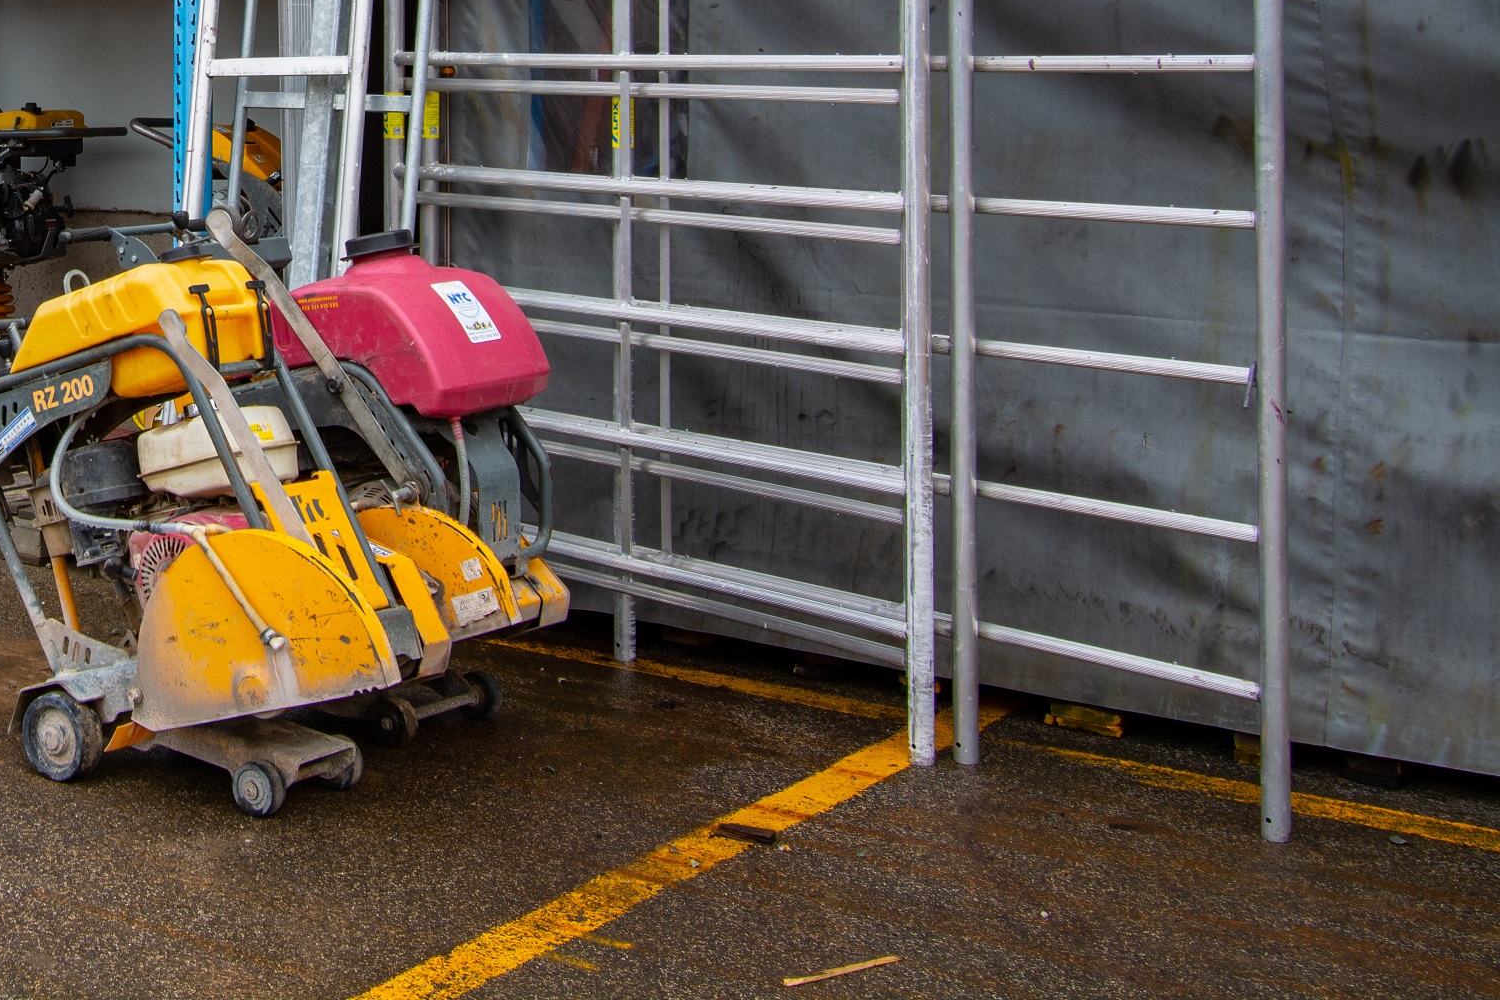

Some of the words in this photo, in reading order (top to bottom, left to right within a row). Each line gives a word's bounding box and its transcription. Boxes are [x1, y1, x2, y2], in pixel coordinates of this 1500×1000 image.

[447, 292, 472, 304] NTC
[32, 386, 60, 413] RZ
[60, 374, 94, 405] 200
